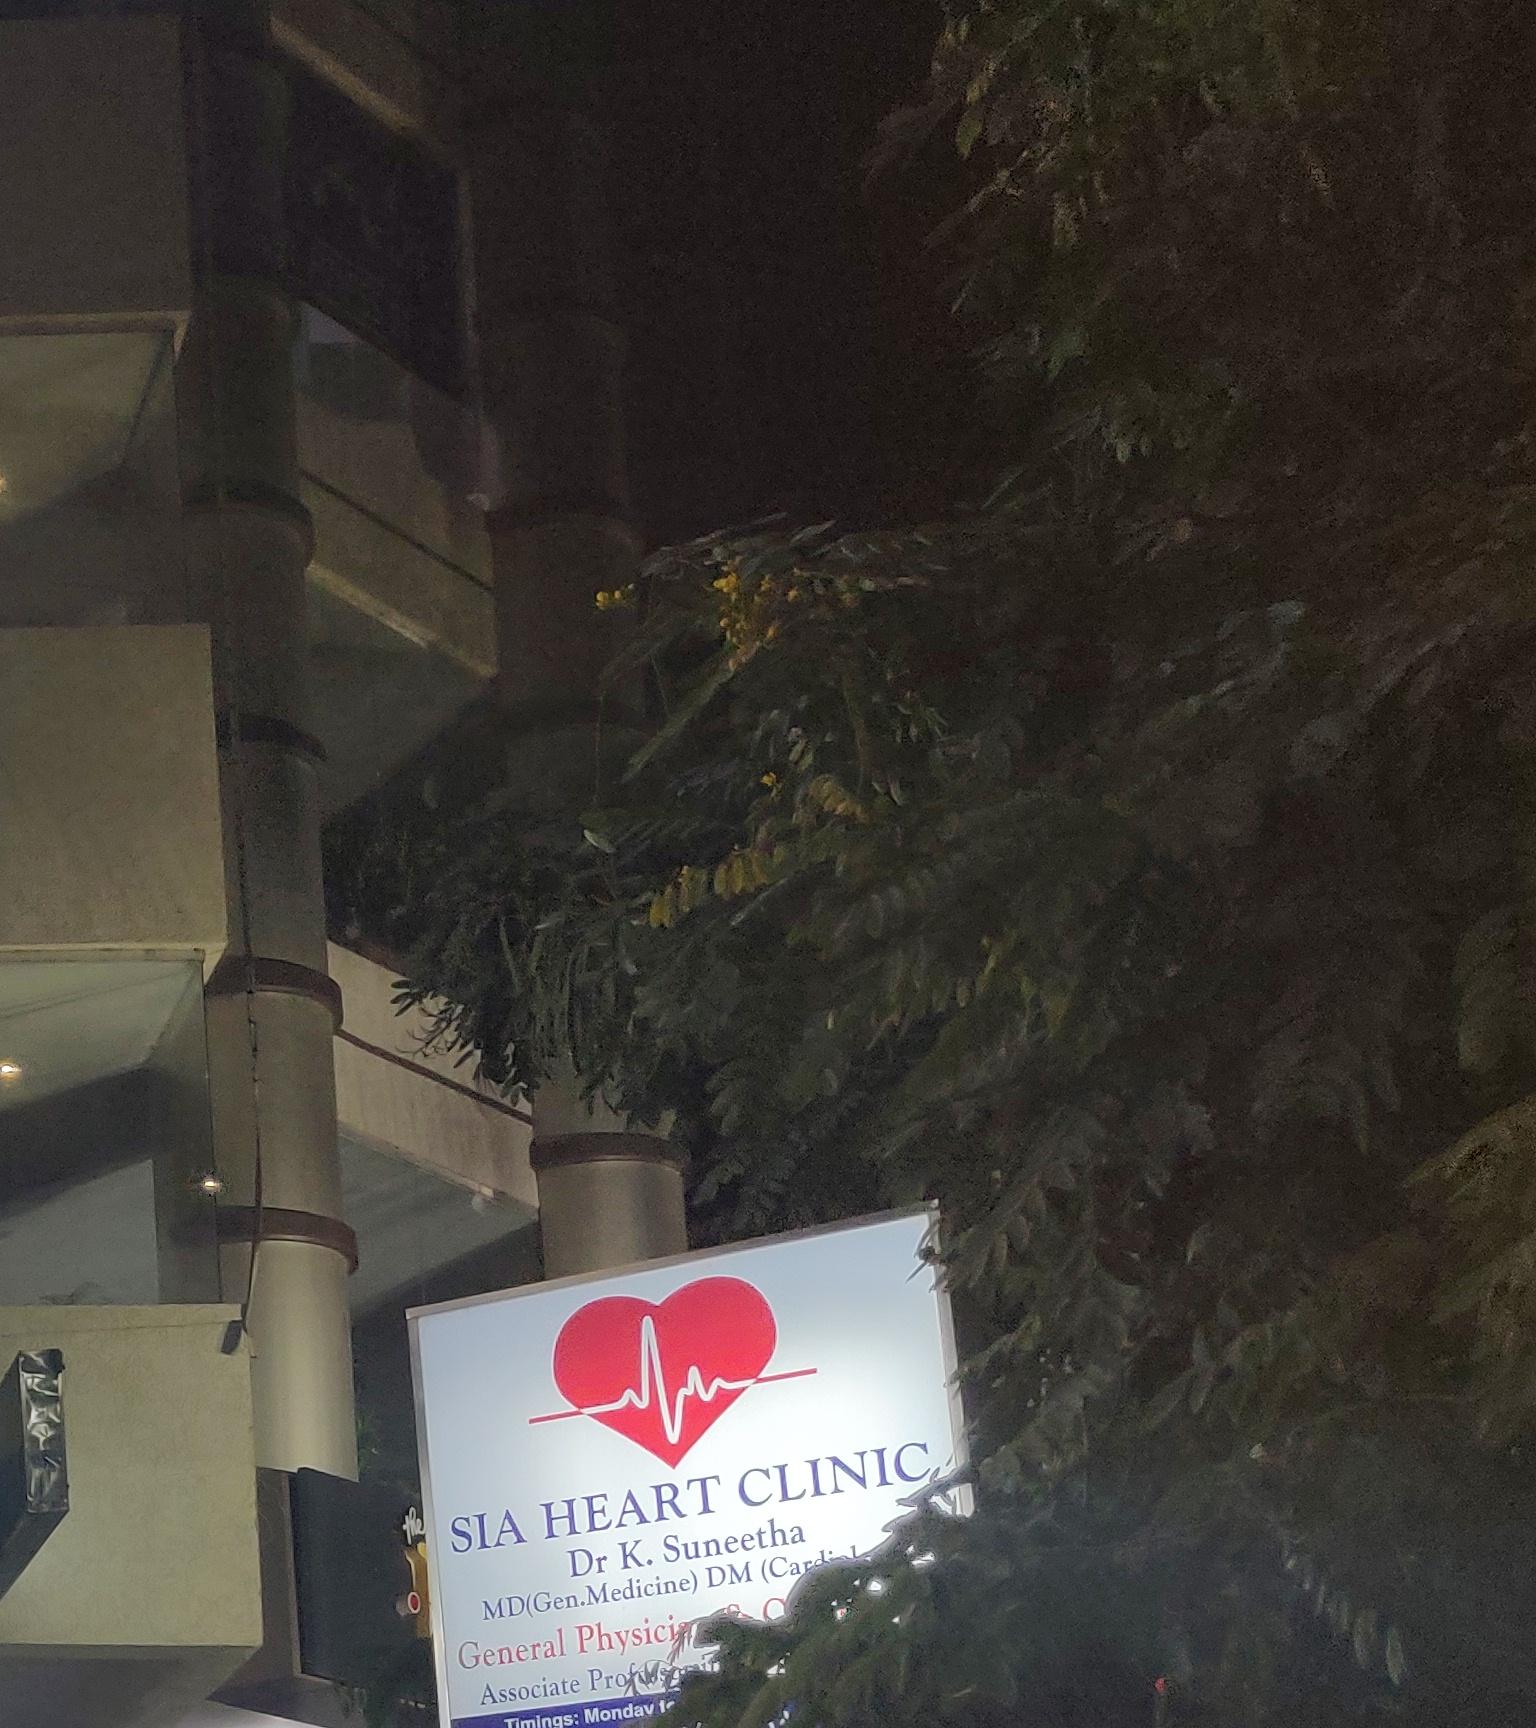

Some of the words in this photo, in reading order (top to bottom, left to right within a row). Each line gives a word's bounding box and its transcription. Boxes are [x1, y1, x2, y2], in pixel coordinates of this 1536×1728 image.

[450, 1508, 528, 1553] SIA
[539, 1474, 721, 1541] HEART
[737, 1441, 931, 1507] CLINIC
[567, 1547, 608, 1578] Dr
[618, 1539, 653, 1570] K.
[663, 1518, 806, 1563] Suneetha
[481, 1569, 699, 1622] MD(Gen.Medicine)
[705, 1560, 753, 1588] DM
[458, 1627, 567, 1670] General
[480, 1676, 581, 1706] Associate
